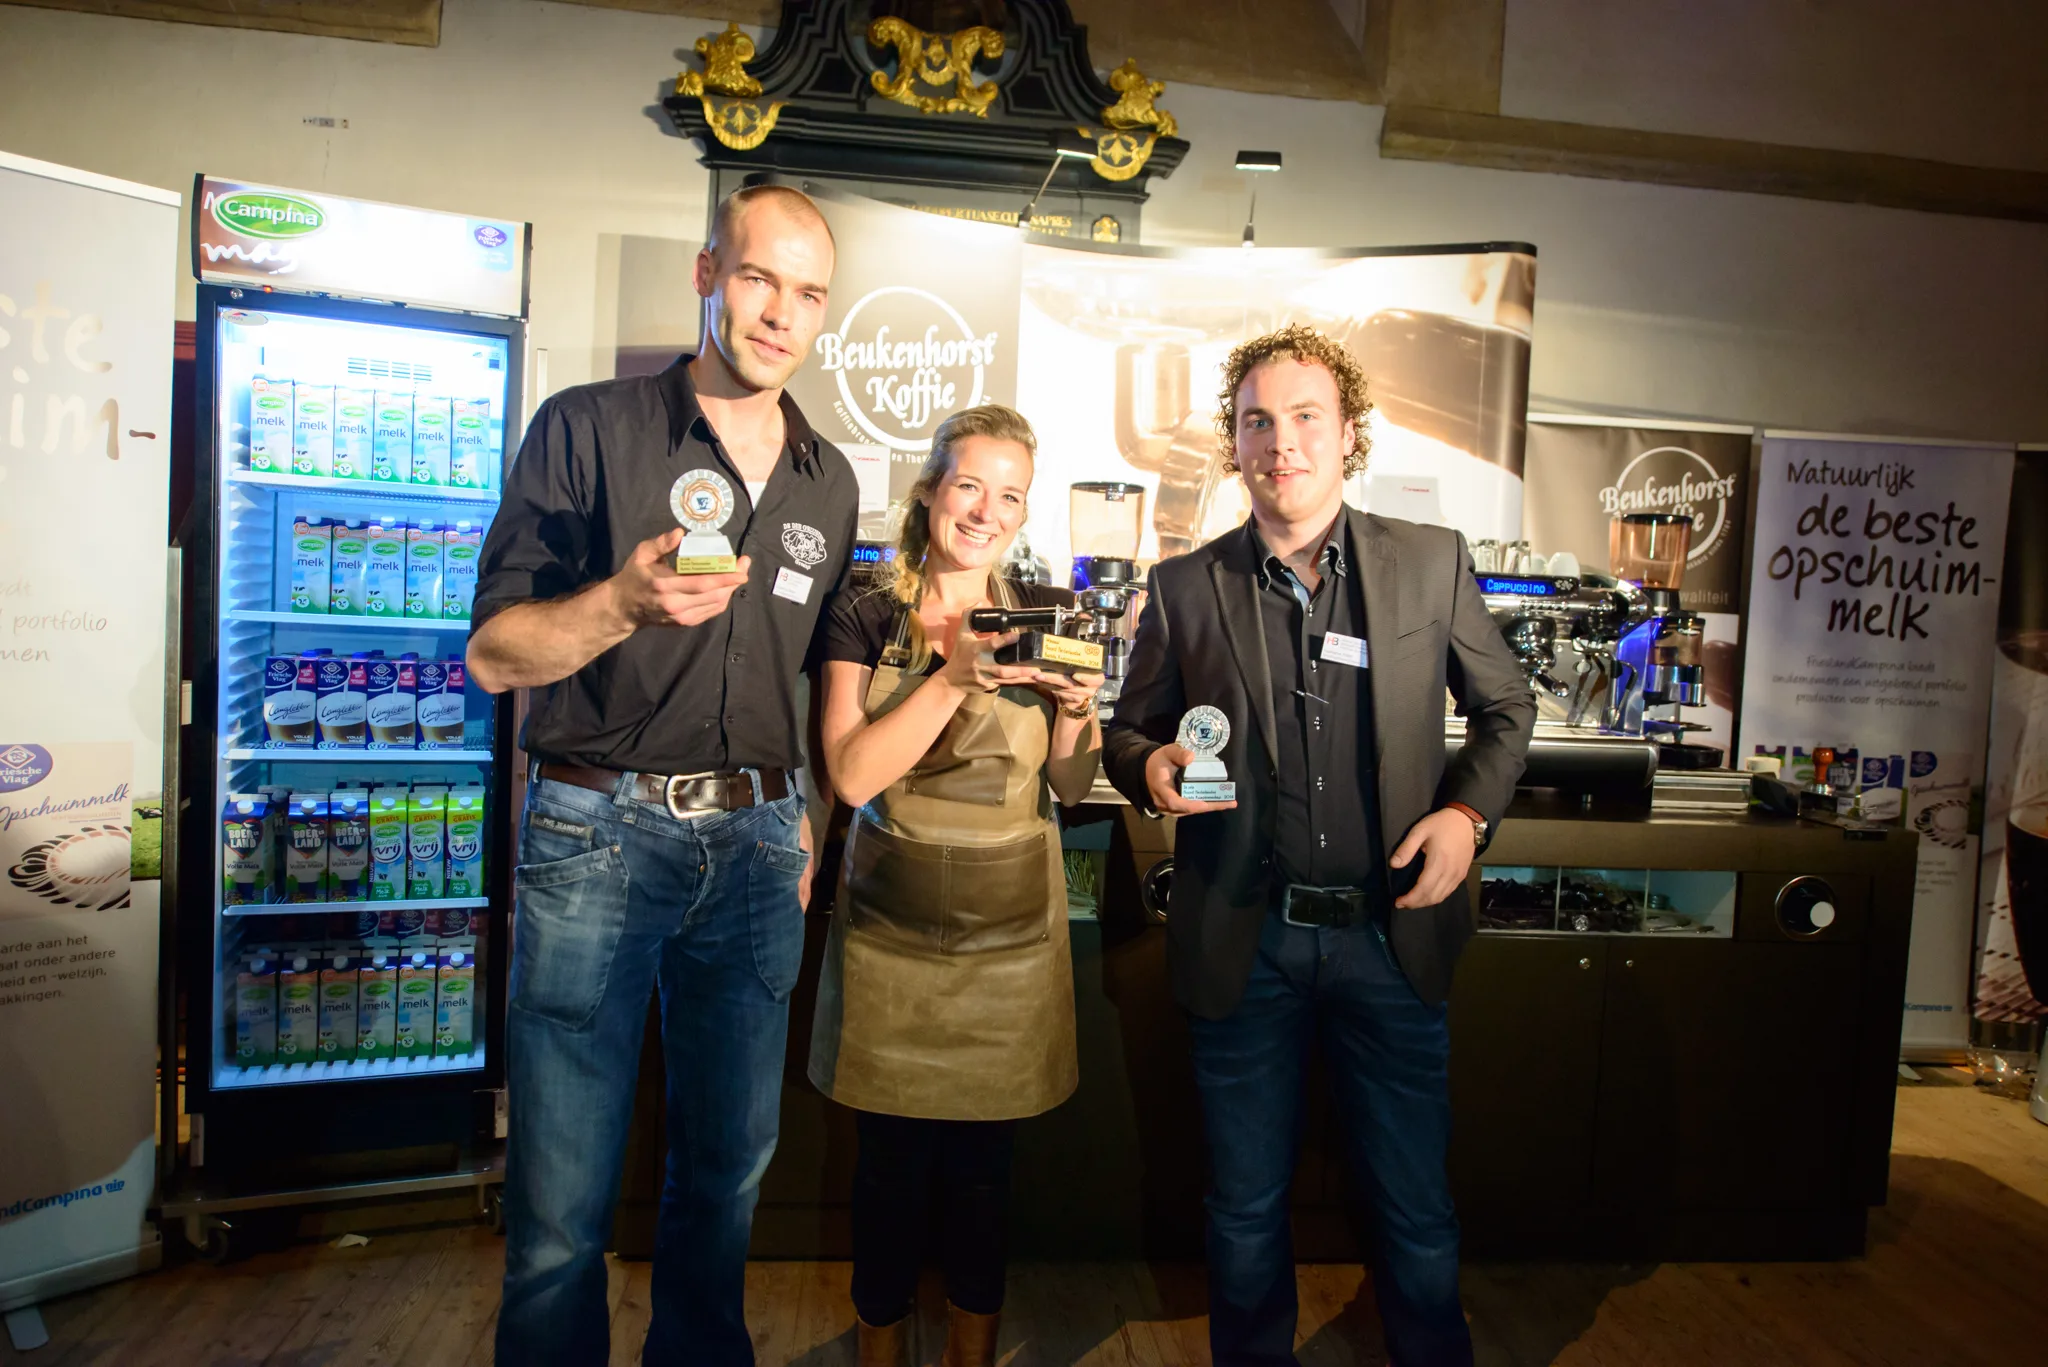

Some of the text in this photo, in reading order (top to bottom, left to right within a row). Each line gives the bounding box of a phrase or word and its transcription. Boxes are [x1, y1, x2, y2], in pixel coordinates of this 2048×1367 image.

[224, 199, 319, 226] Campina
[815, 325, 998, 371] Beukenhorst
[866, 366, 956, 429] Koffie
[257, 416, 285, 426] melk
[300, 421, 327, 430] melk
[340, 425, 367, 434] melk
[380, 429, 406, 438] melk
[418, 432, 444, 441] melk
[457, 436, 483, 445] melk
[1788, 459, 1915, 497] Natuurlijk
[1600, 471, 1735, 513] Beukenhorst
[1797, 493, 1979, 549] de beste
[299, 540, 326, 550] Campina
[338, 543, 364, 552] Campina
[374, 544, 400, 553] Campina
[297, 557, 324, 567] melk
[337, 560, 363, 570] melk
[372, 561, 399, 571] melk
[411, 564, 438, 573] melk
[449, 566, 475, 575] melk
[1768, 545, 1996, 601] opschuim-
[1827, 592, 1929, 642] melk
[13, 609, 107, 637] portfolio
[268, 671, 293, 679] Friesche
[2, 775, 31, 785] Vlag
[376, 816, 400, 825] GRATIS
[414, 814, 437, 822] GRATIS
[228, 829, 253, 839] BOER
[294, 829, 318, 838] BOER
[335, 826, 360, 836] BOER
[230, 838, 256, 848] LAND
[295, 838, 321, 848] LAND
[337, 836, 362, 846] LAND
[374, 843, 401, 861] vrij
[413, 841, 439, 861] vrij
[452, 841, 477, 860] vrij
[37, 940, 62, 950] aan
[66, 935, 88, 946] het
[24, 955, 65, 969] onder
[69, 950, 116, 963] andere
[29, 974, 46, 985] en
[325, 1001, 352, 1012] melk
[364, 1000, 390, 1011] melk
[403, 998, 429, 1009] melk
[442, 997, 468, 1008] melk
[285, 1004, 312, 1014] melk
